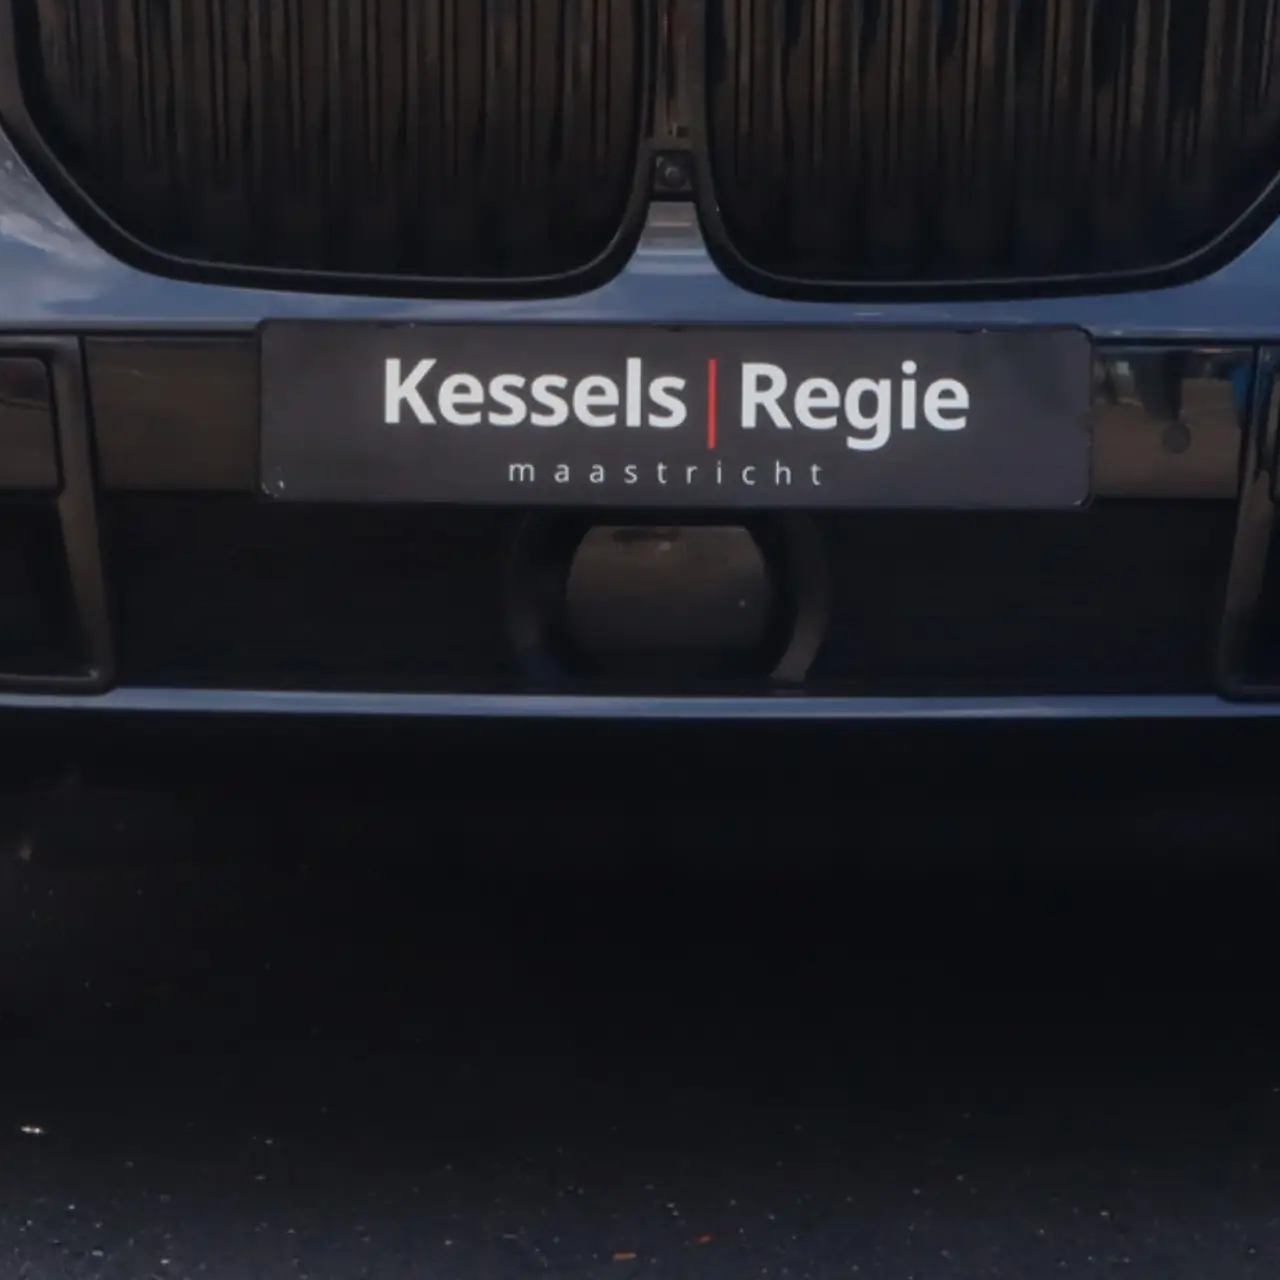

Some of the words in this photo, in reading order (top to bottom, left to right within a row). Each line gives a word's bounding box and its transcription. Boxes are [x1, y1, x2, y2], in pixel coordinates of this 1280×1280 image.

[383, 357, 688, 429] Kessels
[740, 360, 970, 452] Regie
[508, 458, 823, 486] maastricht
